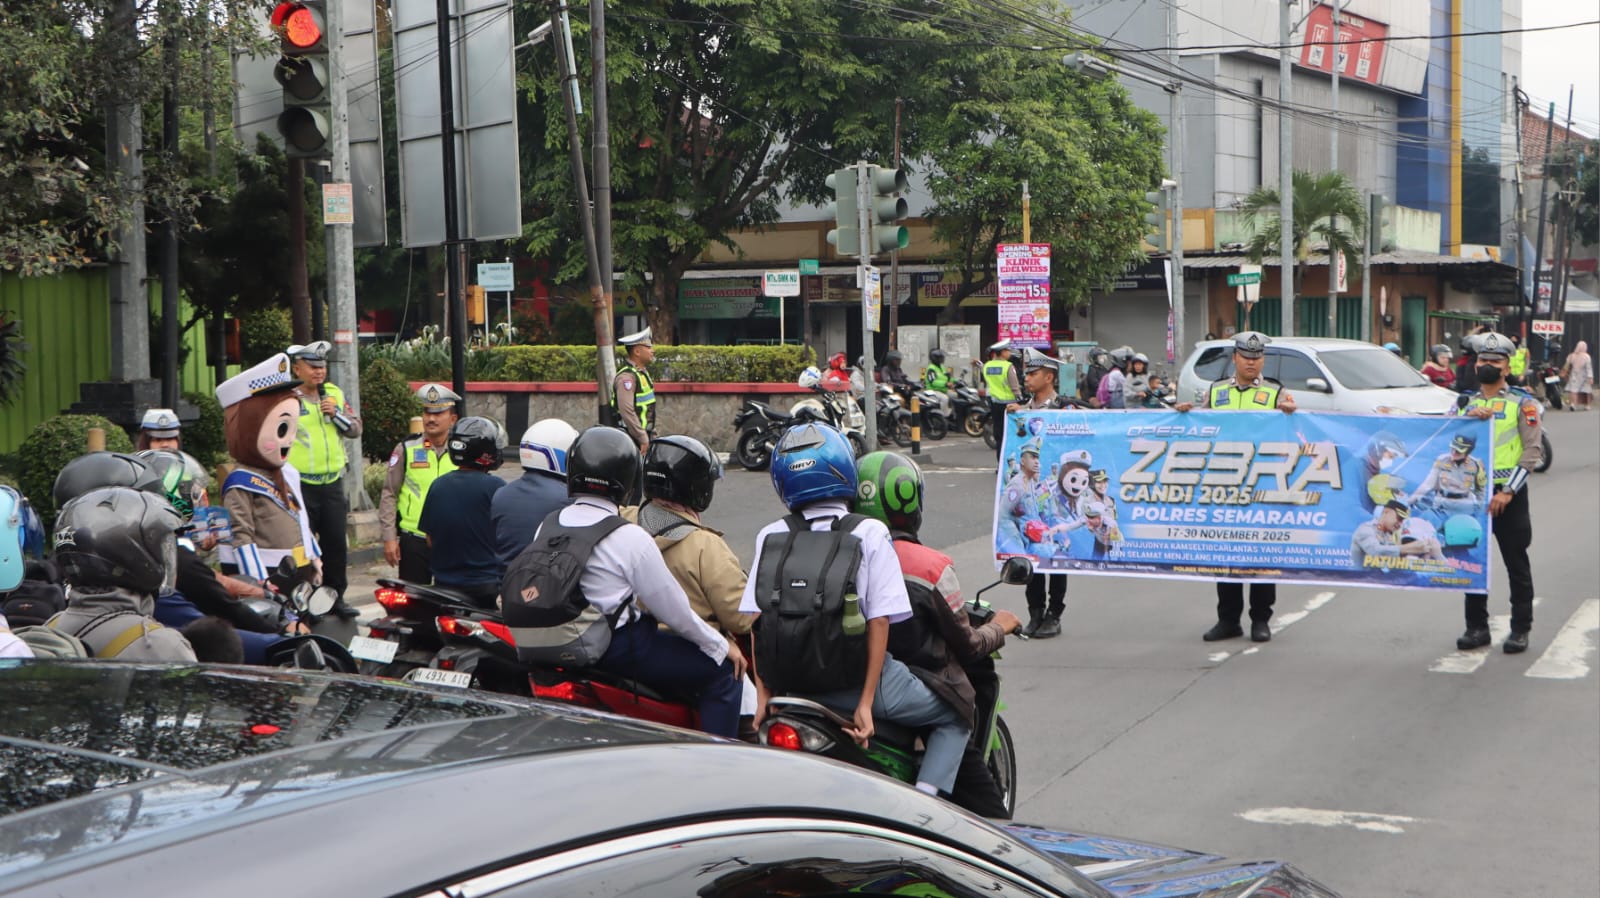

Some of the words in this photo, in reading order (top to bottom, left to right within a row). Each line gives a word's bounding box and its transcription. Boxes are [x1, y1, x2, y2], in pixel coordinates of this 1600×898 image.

[1005, 258, 1041, 266] KLINIK
[1127, 426, 1222, 437] OPERASI
[1119, 440, 1343, 500] ZEBRA
[584, 477, 609, 486] HONDA
[1119, 484, 1194, 503] CANDI
[1197, 486, 1252, 506] 2025
[1131, 506, 1208, 523] POLRES
[1212, 509, 1328, 527] SEMARANG
[1167, 528, 1198, 537] 17-30
[1200, 529, 1259, 540] NOVEMBER
[1262, 531, 1291, 541] 2025
[1112, 541, 1169, 550] TERWUJUDNYA
[1170, 542, 1258, 553] KAMSELTIBCARLANTAS
[1261, 545, 1283, 554] YANG
[1285, 546, 1313, 556] AMAN,
[1315, 548, 1352, 557] NYAMAN
[1127, 551, 1162, 559] SELAMAT
[1164, 552, 1211, 561] MENJELANG
[1213, 553, 1271, 563] PELAKSANAAN
[1272, 556, 1309, 565] OPERASI
[1310, 558, 1332, 566] LILIN
[1334, 559, 1354, 567] 2025
[1363, 554, 1410, 570] PATUHI
[425, 670, 447, 682] 4934
